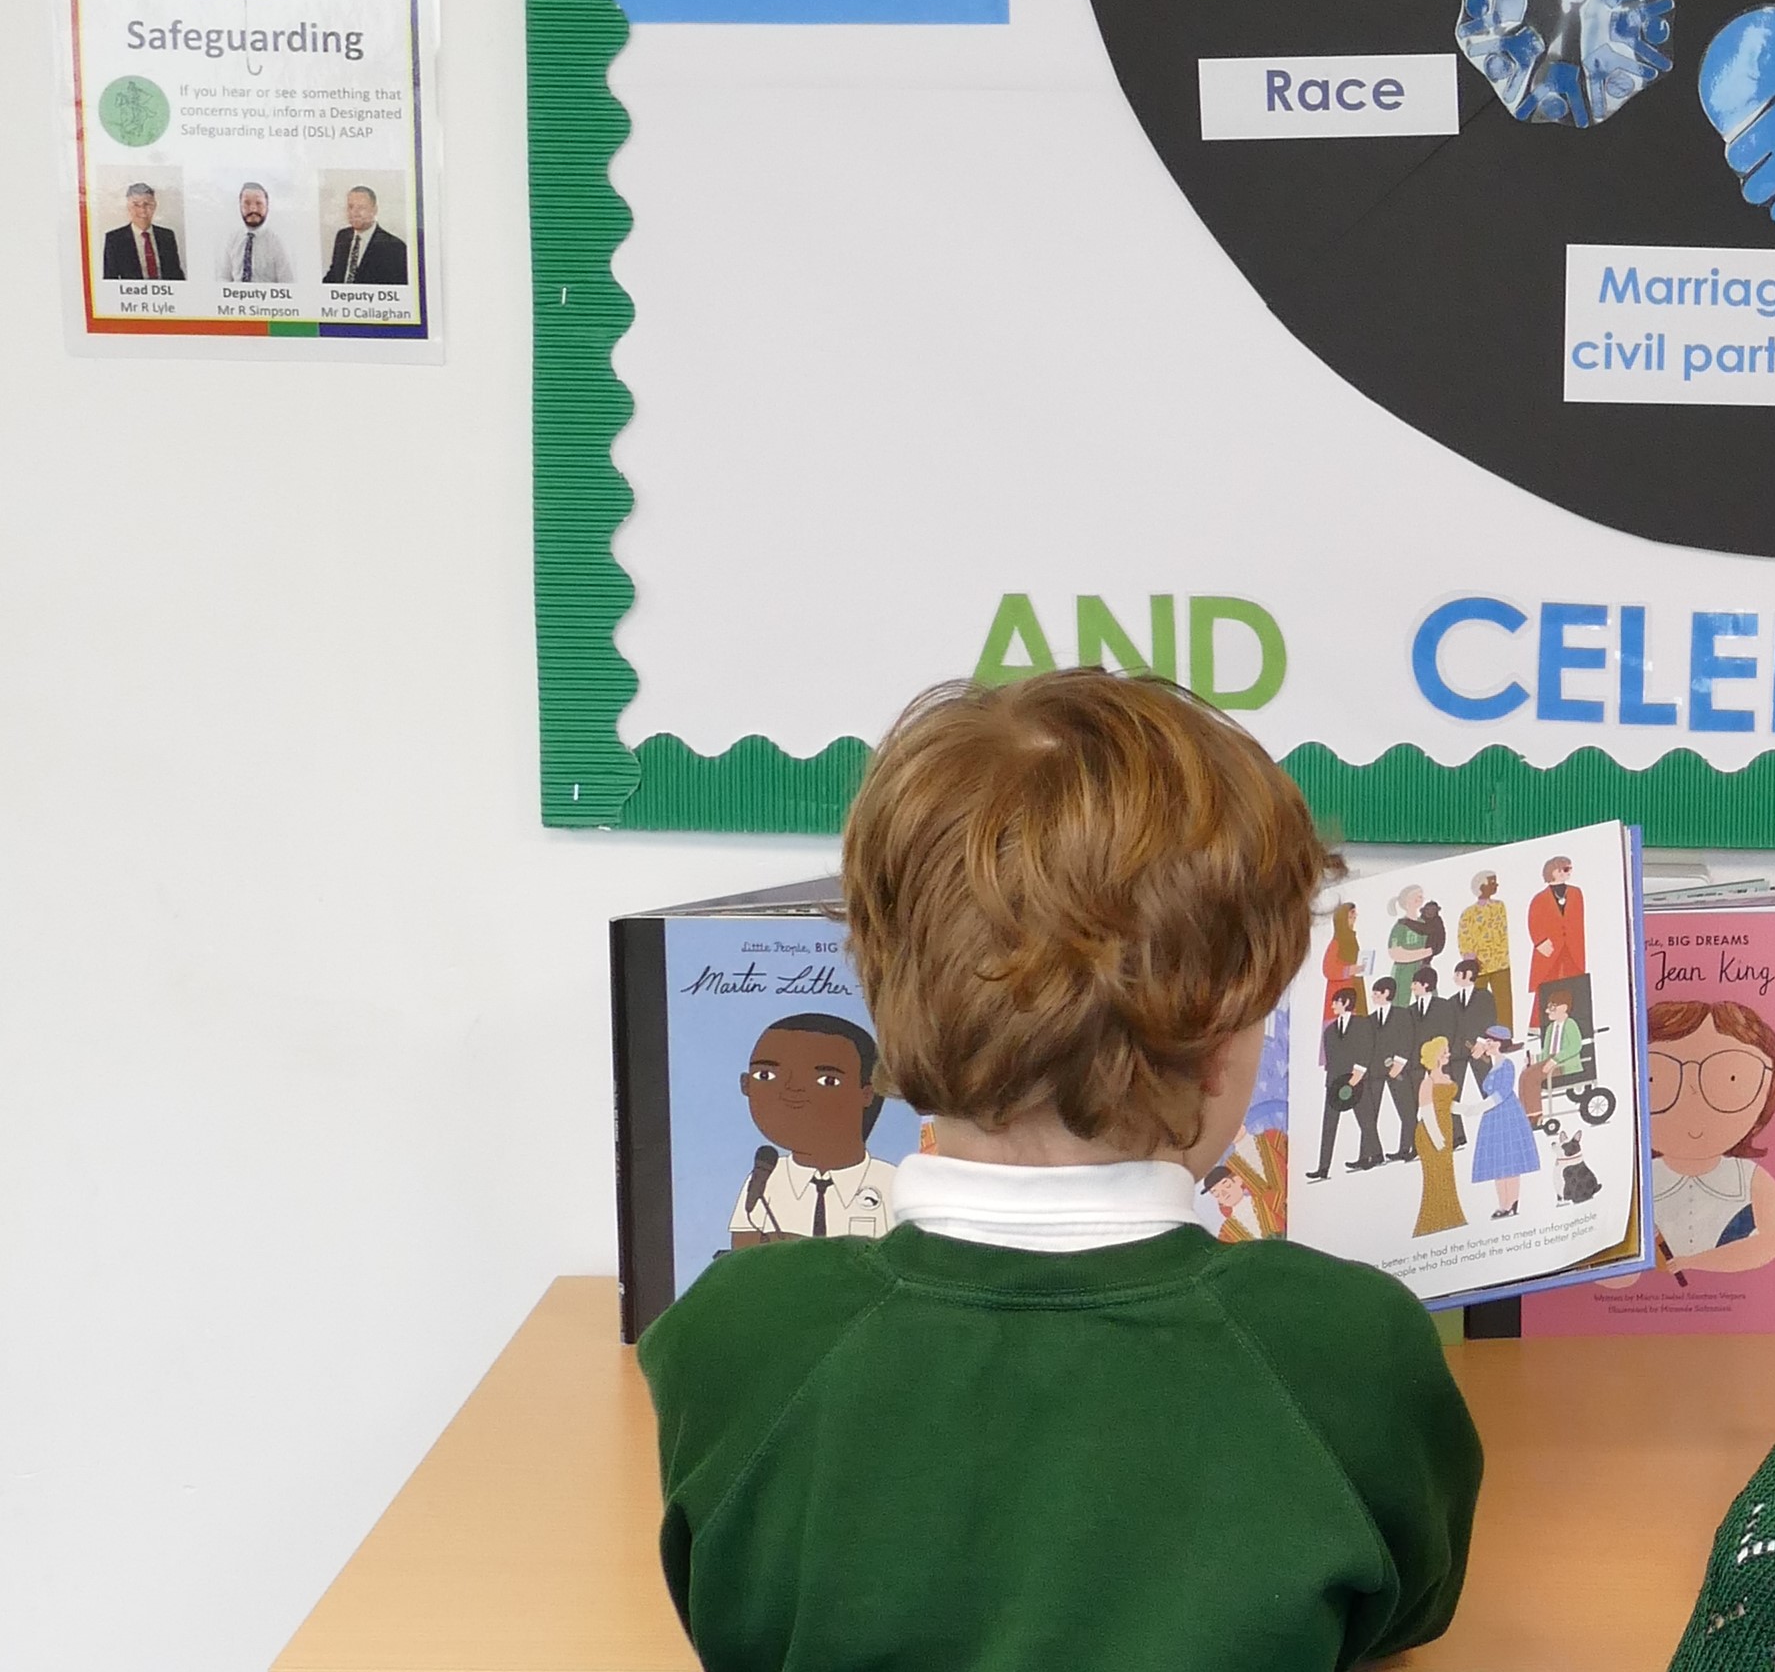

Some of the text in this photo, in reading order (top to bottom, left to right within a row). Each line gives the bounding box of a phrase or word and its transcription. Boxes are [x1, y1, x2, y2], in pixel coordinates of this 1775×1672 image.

[127, 19, 364, 61] Safeguarding
[179, 85, 402, 102] If you hear or see something that
[1265, 68, 1406, 113] Race
[180, 107, 238, 117] concerns
[273, 107, 315, 118] inform
[319, 110, 326, 119] a
[330, 107, 402, 121] Designated
[181, 124, 373, 140] Safeguarding Lead (DSL) ASAP
[120, 285, 174, 296] Lead DSL
[223, 288, 292, 301] Deputy DSL
[330, 290, 400, 303] Deputy DSL
[121, 303, 175, 315] Mr R Lyle
[218, 305, 300, 318] Mr R Simpson
[321, 307, 411, 321] Mr D Callaghan
[1571, 333, 1666, 373] civil
[972, 592, 1288, 711] AND
[1668, 936, 1690, 946] BIG
[1696, 935, 1749, 945] DREAMS
[742, 942, 838, 956] Little People, BIG
[680, 962, 766, 995] Martin
[776, 965, 852, 995] Luther
[1650, 951, 1775, 996] Jean King
[1431, 1245, 1447, 1257] had
[1450, 1243, 1464, 1252] the
[1467, 1234, 1499, 1249] fortune
[1513, 1229, 1536, 1239] meet
[1441, 1255, 1458, 1266] had
[1460, 1251, 1486, 1262] made
[1489, 1247, 1503, 1256] the
[1507, 1240, 1531, 1252] world
